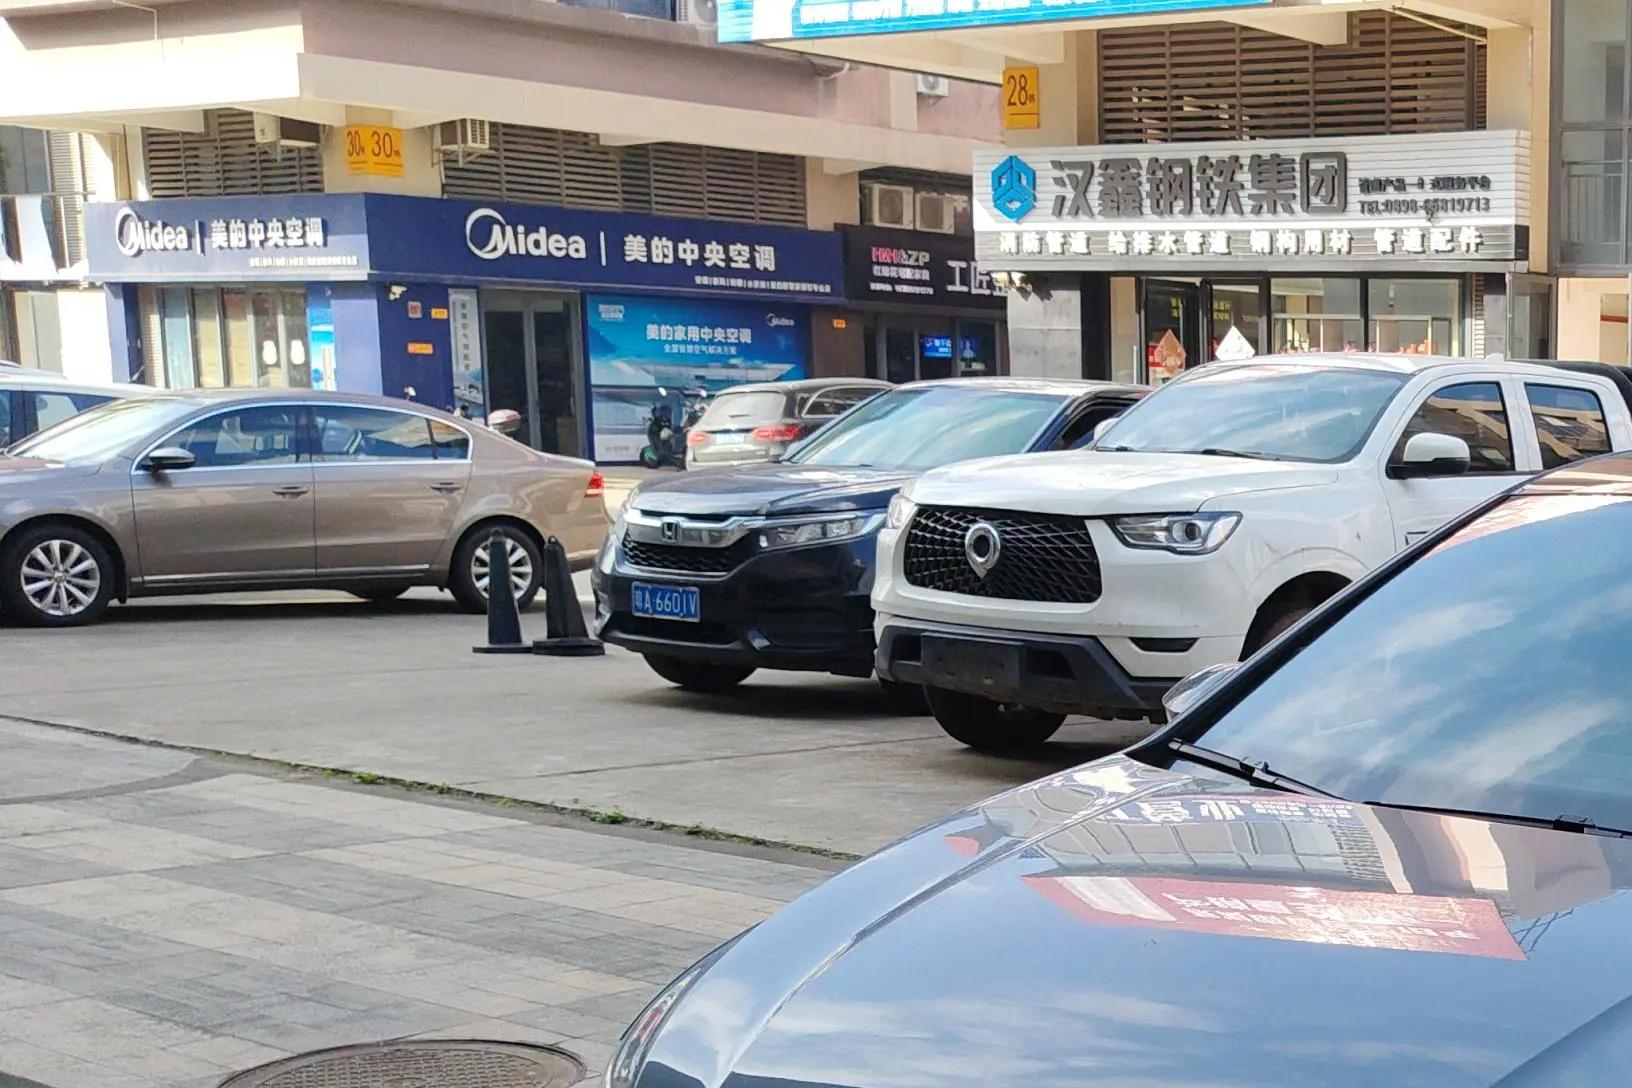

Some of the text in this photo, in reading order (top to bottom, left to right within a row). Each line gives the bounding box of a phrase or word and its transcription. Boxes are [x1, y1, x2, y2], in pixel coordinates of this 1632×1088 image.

[1050, 151, 1347, 218] 汉鑫钢铁集团
[115, 207, 188, 257] Midea
[210, 217, 325, 250] 美的中央空调
[465, 207, 587, 260] Midea
[624, 233, 776, 272] 美的中央空调
